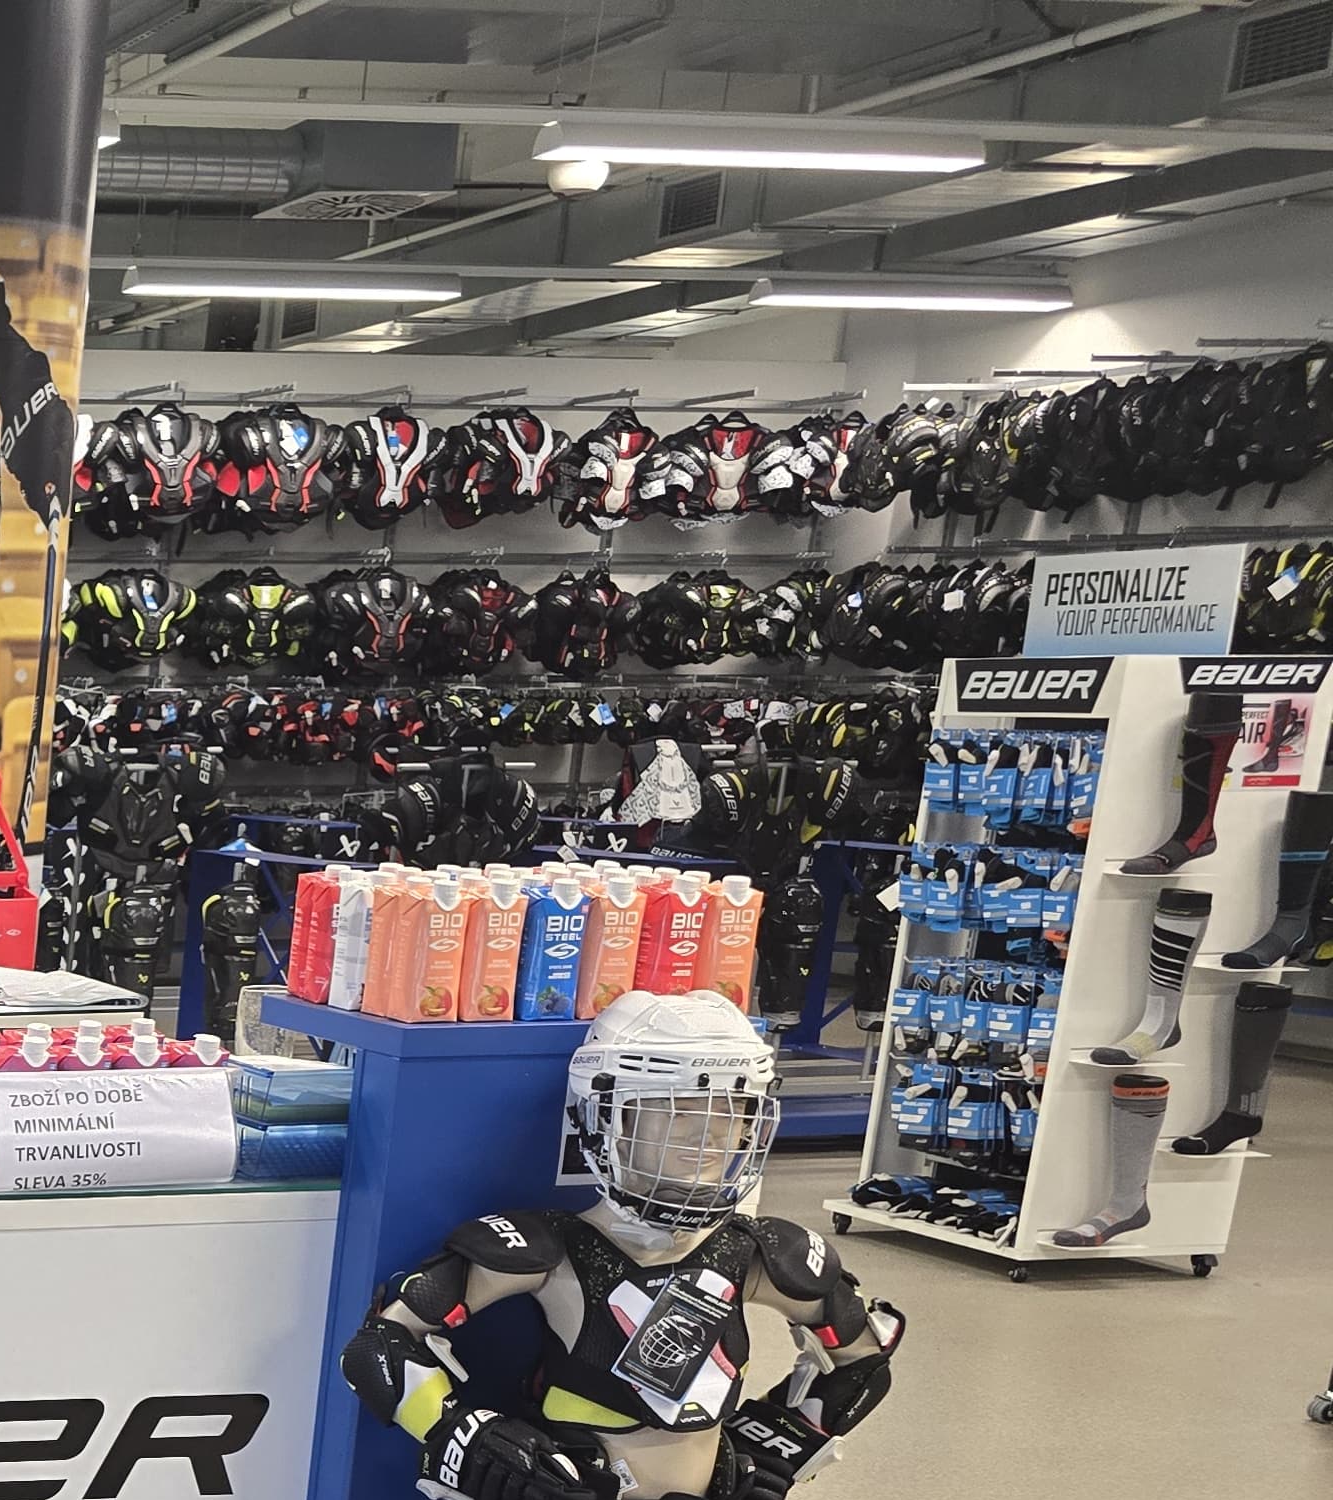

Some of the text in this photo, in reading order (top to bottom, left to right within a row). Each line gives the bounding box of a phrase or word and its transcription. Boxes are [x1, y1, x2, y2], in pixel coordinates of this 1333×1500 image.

[1044, 565, 1190, 607] PERSONALIZE
[1056, 603, 1219, 636] YOUR PERFORMANCE
[1187, 663, 1325, 687] BAUER
[960, 668, 1099, 702] BAUER
[430, 913, 463, 928] BIO
[488, 912, 522, 927] BIO
[546, 915, 584, 932] BIO
[604, 911, 638, 926] BIO
[671, 912, 705, 929] BIO
[720, 909, 755, 924] BIO
[429, 929, 462, 937] STEEL
[487, 928, 519, 936] STEEL
[603, 926, 636, 935] STEEL
[670, 931, 701, 939] STEEL
[719, 925, 752, 933] STEEL
[545, 933, 582, 941] STEEL
[690, 1057, 751, 1067] BAUER
[8, 1085, 144, 1107] ZBOŽÍ PO DOBĚ
[13, 1112, 115, 1134] MINIMÁLNÍ
[15, 1141, 142, 1163] TRVANLIVOSTI
[13, 1172, 107, 1190] SLEVA 35%
